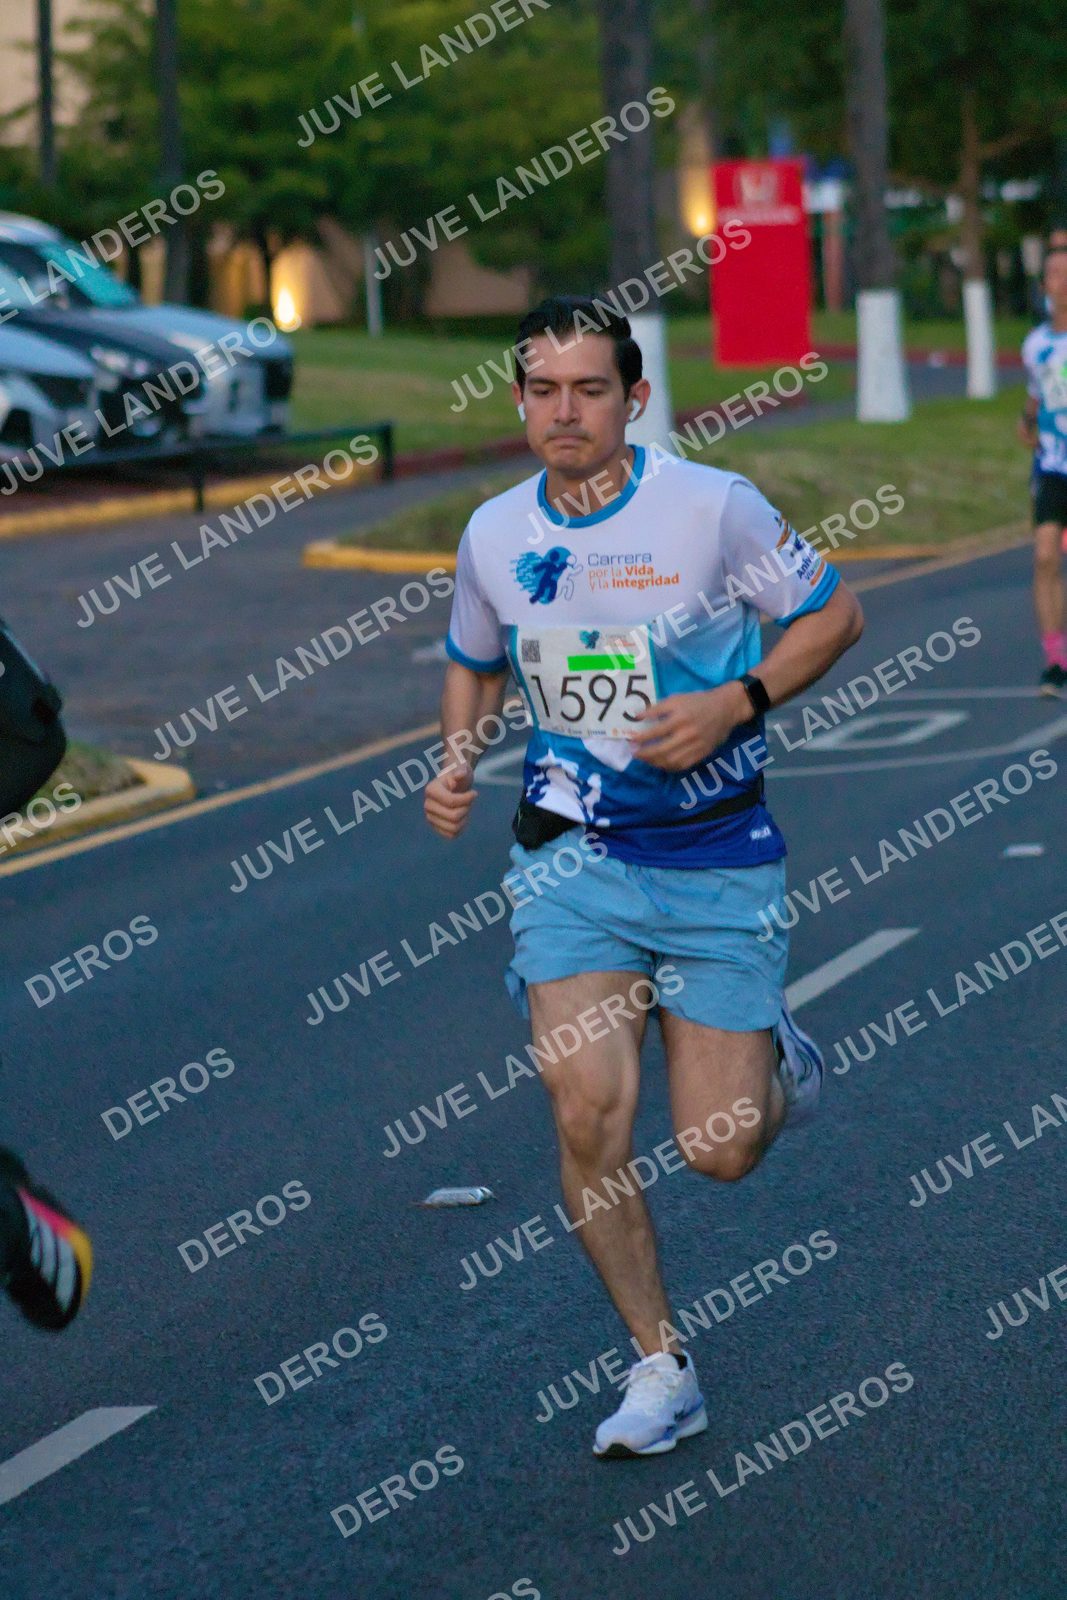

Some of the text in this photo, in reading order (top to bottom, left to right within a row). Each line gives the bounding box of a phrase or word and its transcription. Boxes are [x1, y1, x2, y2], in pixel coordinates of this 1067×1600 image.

[588, 552, 652, 566] Carrera
[588, 564, 654, 580] por la Vida
[598, 578, 609, 590] la
[612, 572, 680, 590] Integridad
[530, 674, 652, 722] 1595
